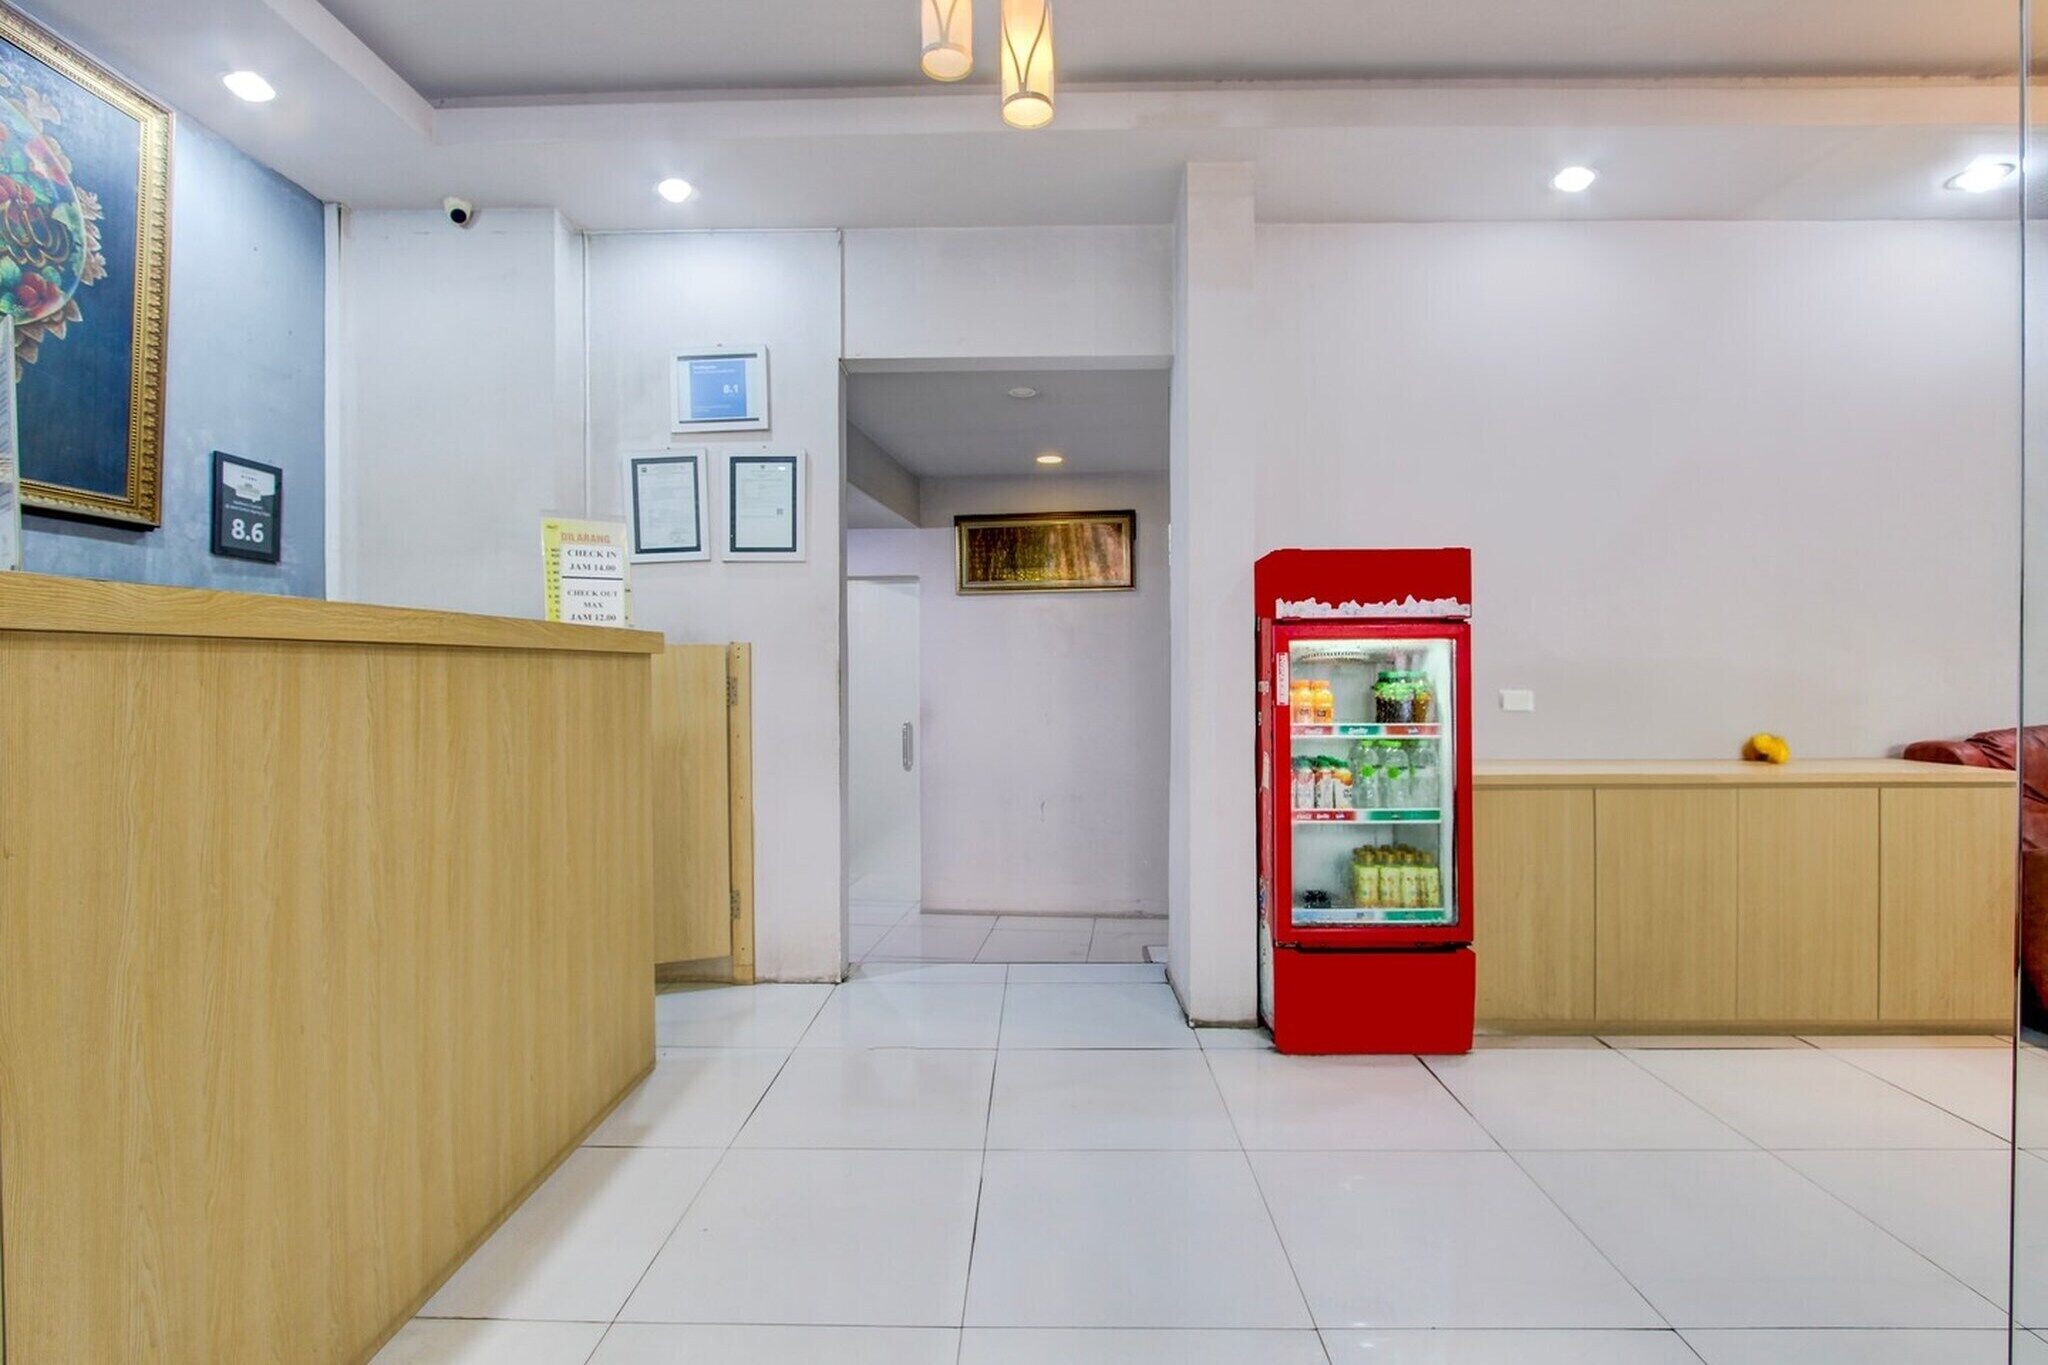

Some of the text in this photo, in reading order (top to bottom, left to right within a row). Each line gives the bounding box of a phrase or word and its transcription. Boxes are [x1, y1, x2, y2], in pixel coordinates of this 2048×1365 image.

[231, 518, 264, 543] 8.6
[567, 549, 617, 558] CHECK IN
[570, 563, 591, 571] JAM
[567, 589, 599, 597] CHECK
[571, 613, 592, 621] JAM
